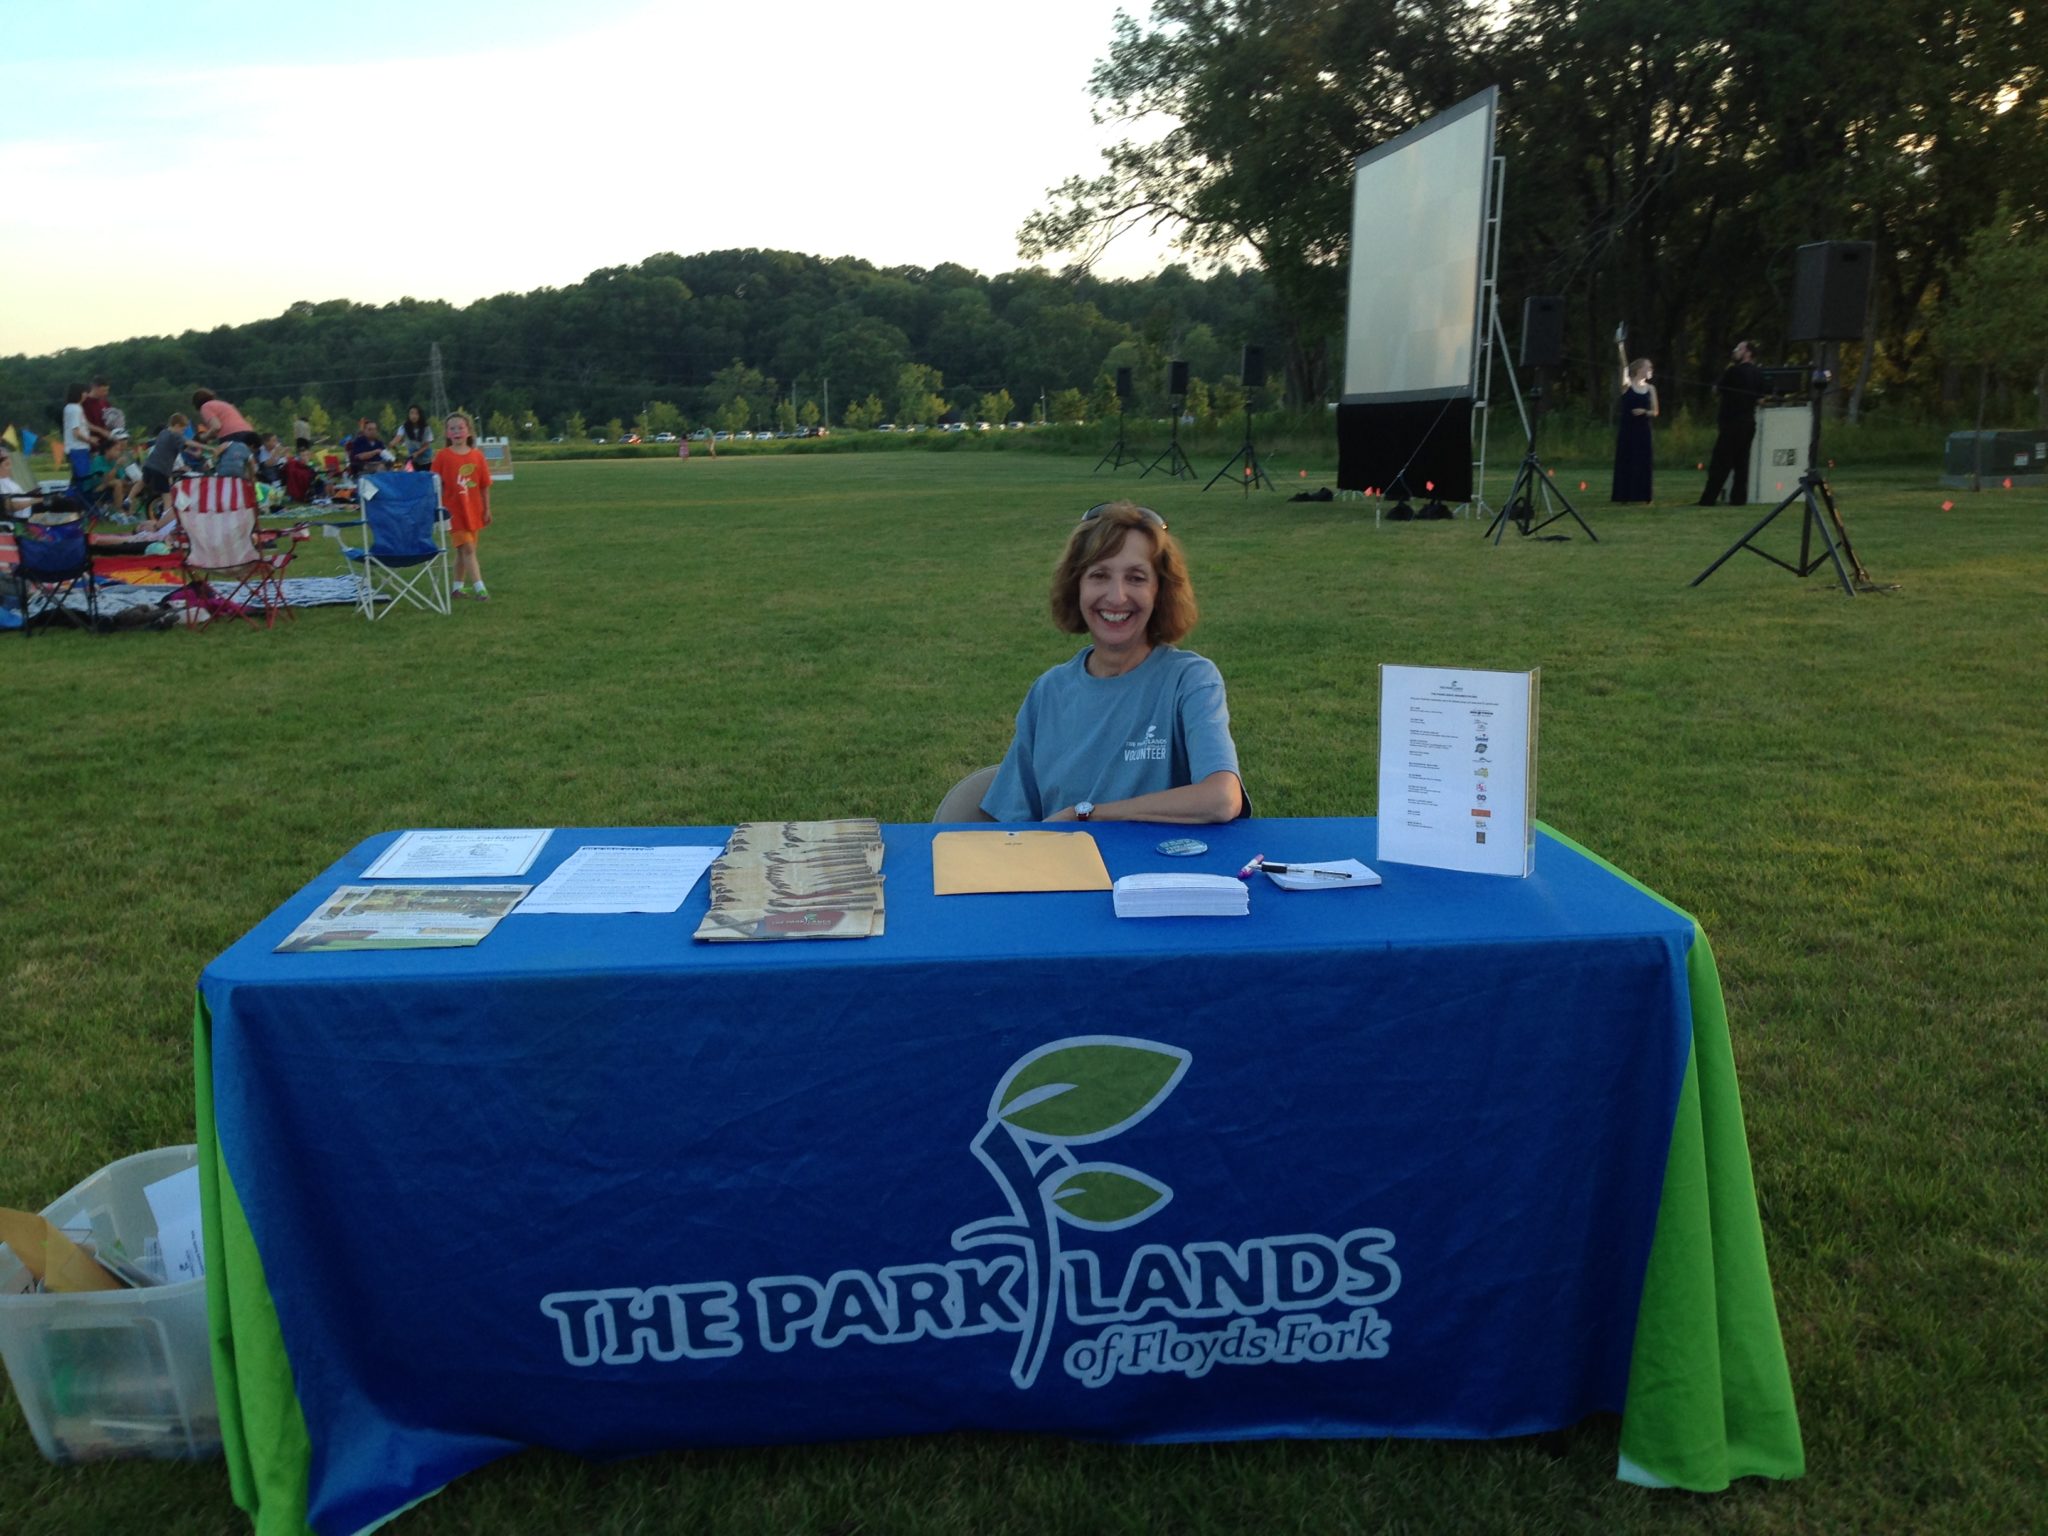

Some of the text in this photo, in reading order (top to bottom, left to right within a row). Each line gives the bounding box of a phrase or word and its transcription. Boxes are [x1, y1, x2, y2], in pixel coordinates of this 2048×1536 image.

[1124, 748, 1166, 761] VOLUNTEER
[541, 1281, 743, 1366] THE
[1067, 1311, 1387, 1384] of Floyds Fork
